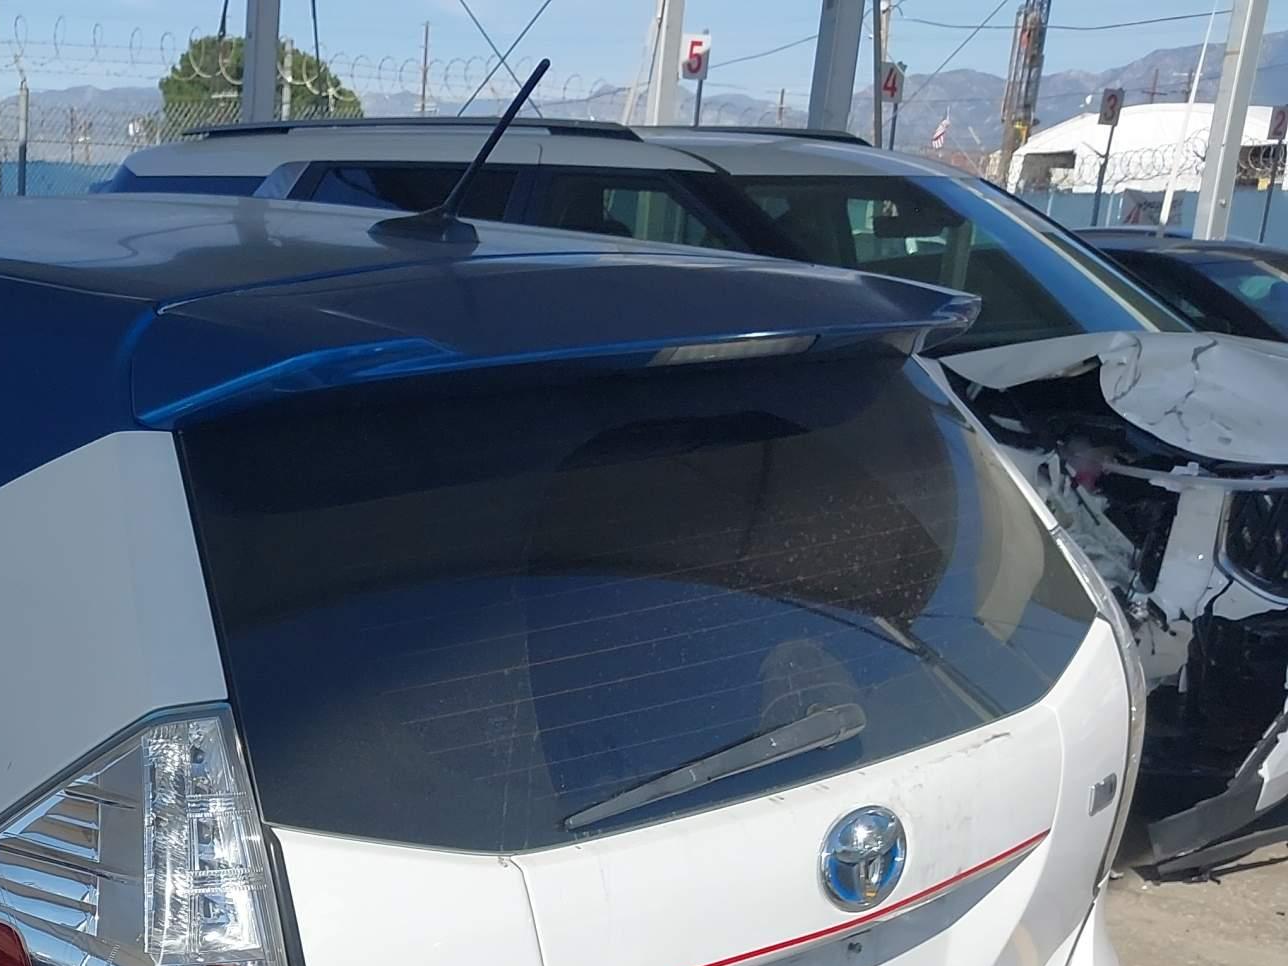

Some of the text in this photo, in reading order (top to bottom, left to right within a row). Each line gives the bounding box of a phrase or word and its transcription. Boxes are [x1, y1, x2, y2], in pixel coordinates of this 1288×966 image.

[687, 40, 703, 74] 5
[883, 67, 897, 98] 4
[1103, 94, 1118, 121] 3
